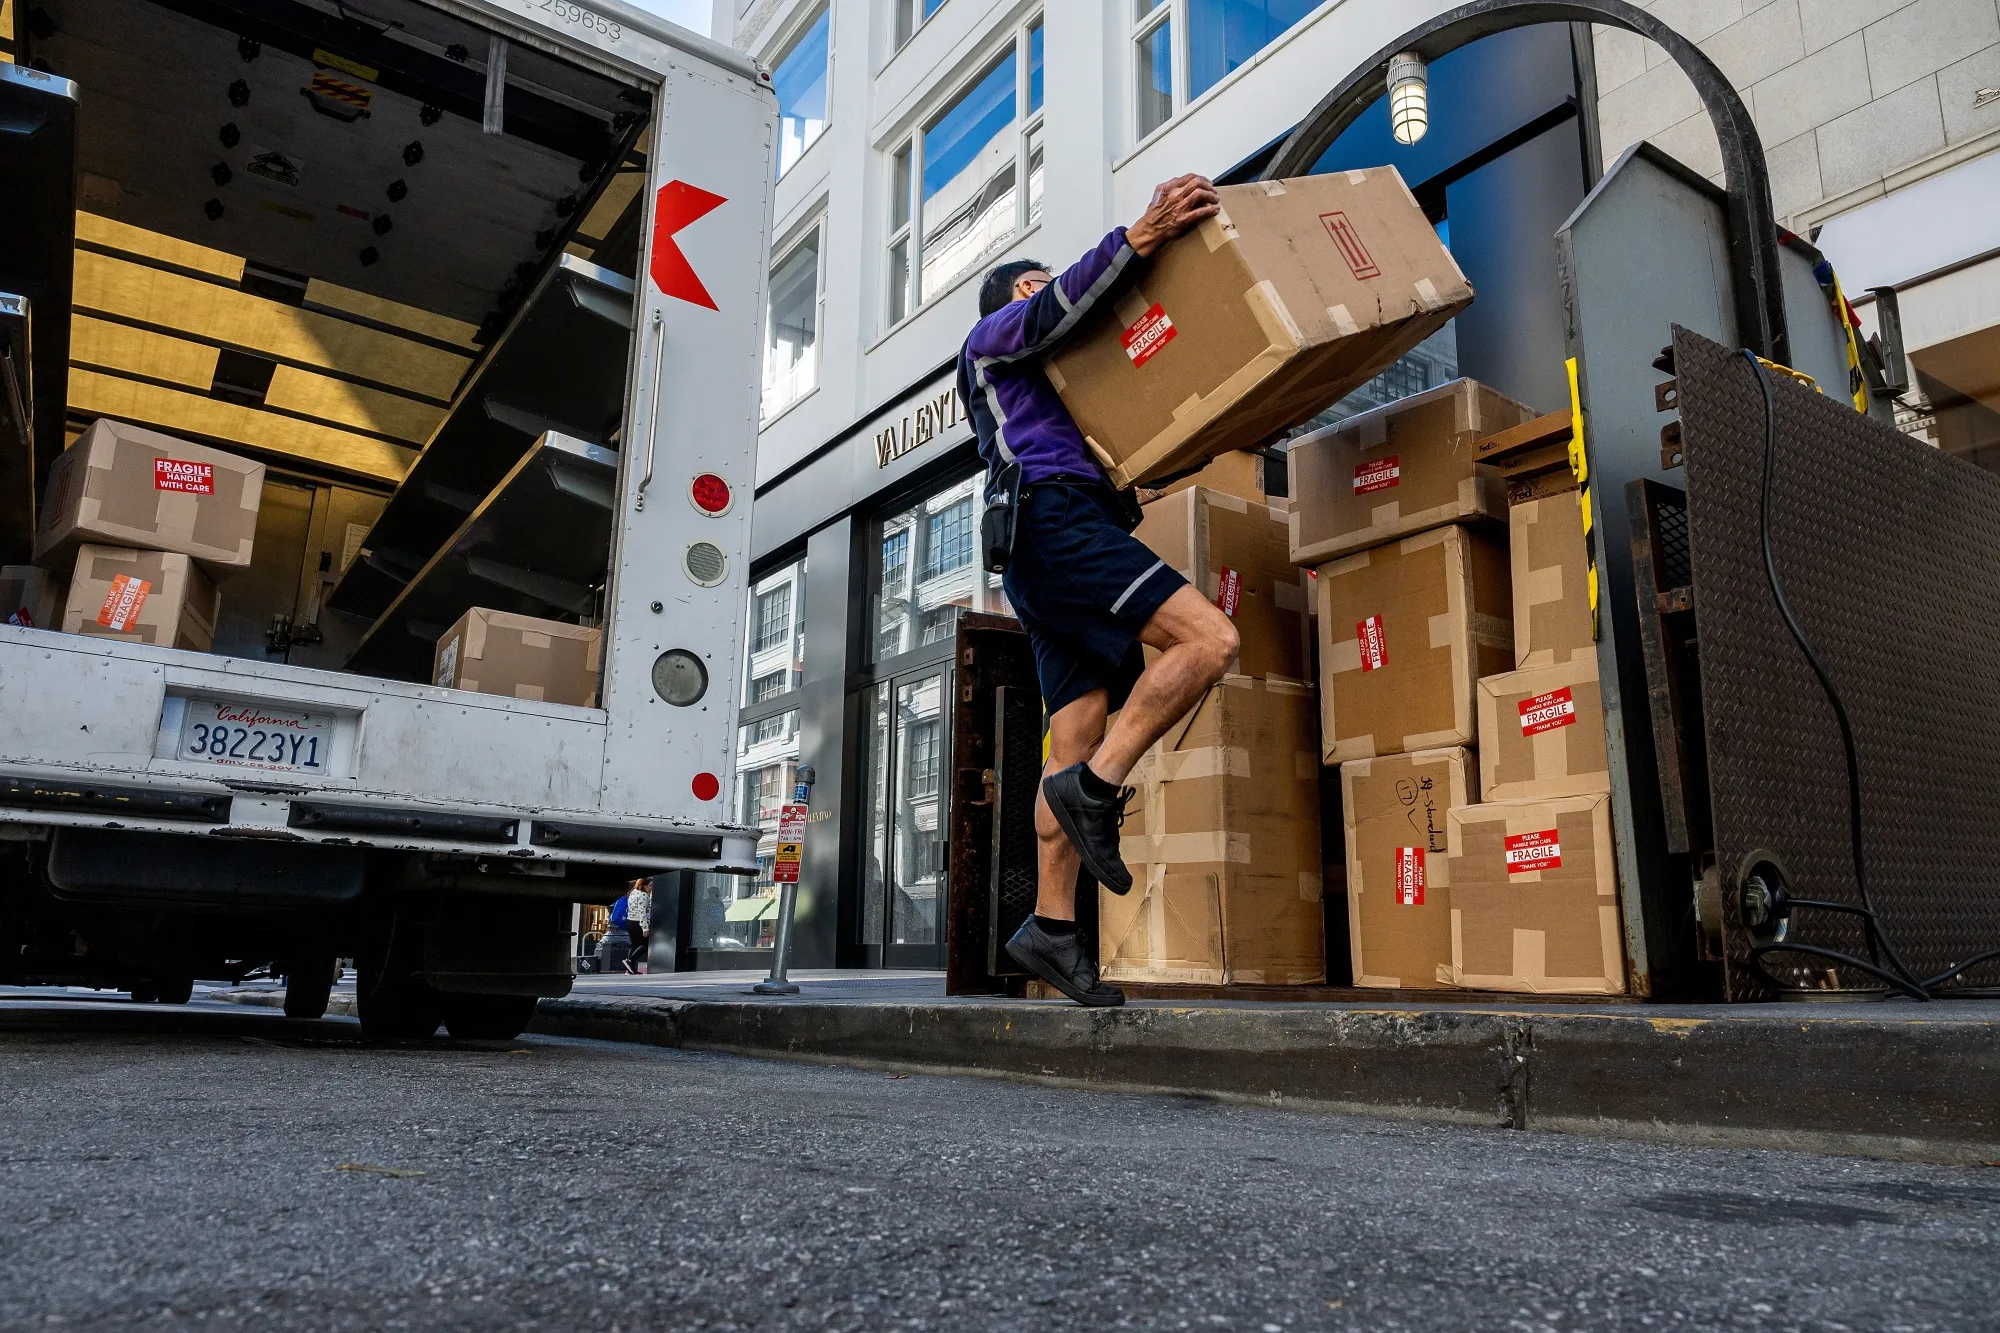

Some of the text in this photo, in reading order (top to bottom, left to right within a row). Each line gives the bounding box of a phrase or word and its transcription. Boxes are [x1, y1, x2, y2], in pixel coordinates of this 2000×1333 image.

[540, 0, 621, 40] 259653
[1132, 316, 1149, 331] PLEASE
[1132, 320, 1167, 354] FRAGILE
[157, 461, 211, 476] FRAGILE
[1358, 469, 1394, 485] FRAGILE
[160, 480, 209, 492] WITH CARE
[167, 473, 202, 483] HANDLE
[104, 590, 116, 608] PLEASE
[1226, 576, 1236, 610] FRAGILE
[114, 582, 138, 624] FRAGILE
[1368, 623, 1380, 662] FRAGILE
[1536, 694, 1553, 703] PLEASE
[217, 705, 309, 730] California
[1527, 704, 1567, 724] FRAGILE
[190, 723, 320, 768] 38223Y1
[216, 758, 293, 771] dmv.ca.gov
[1522, 833, 1540, 841] PLEASE
[1513, 847, 1553, 861] FRAGILE
